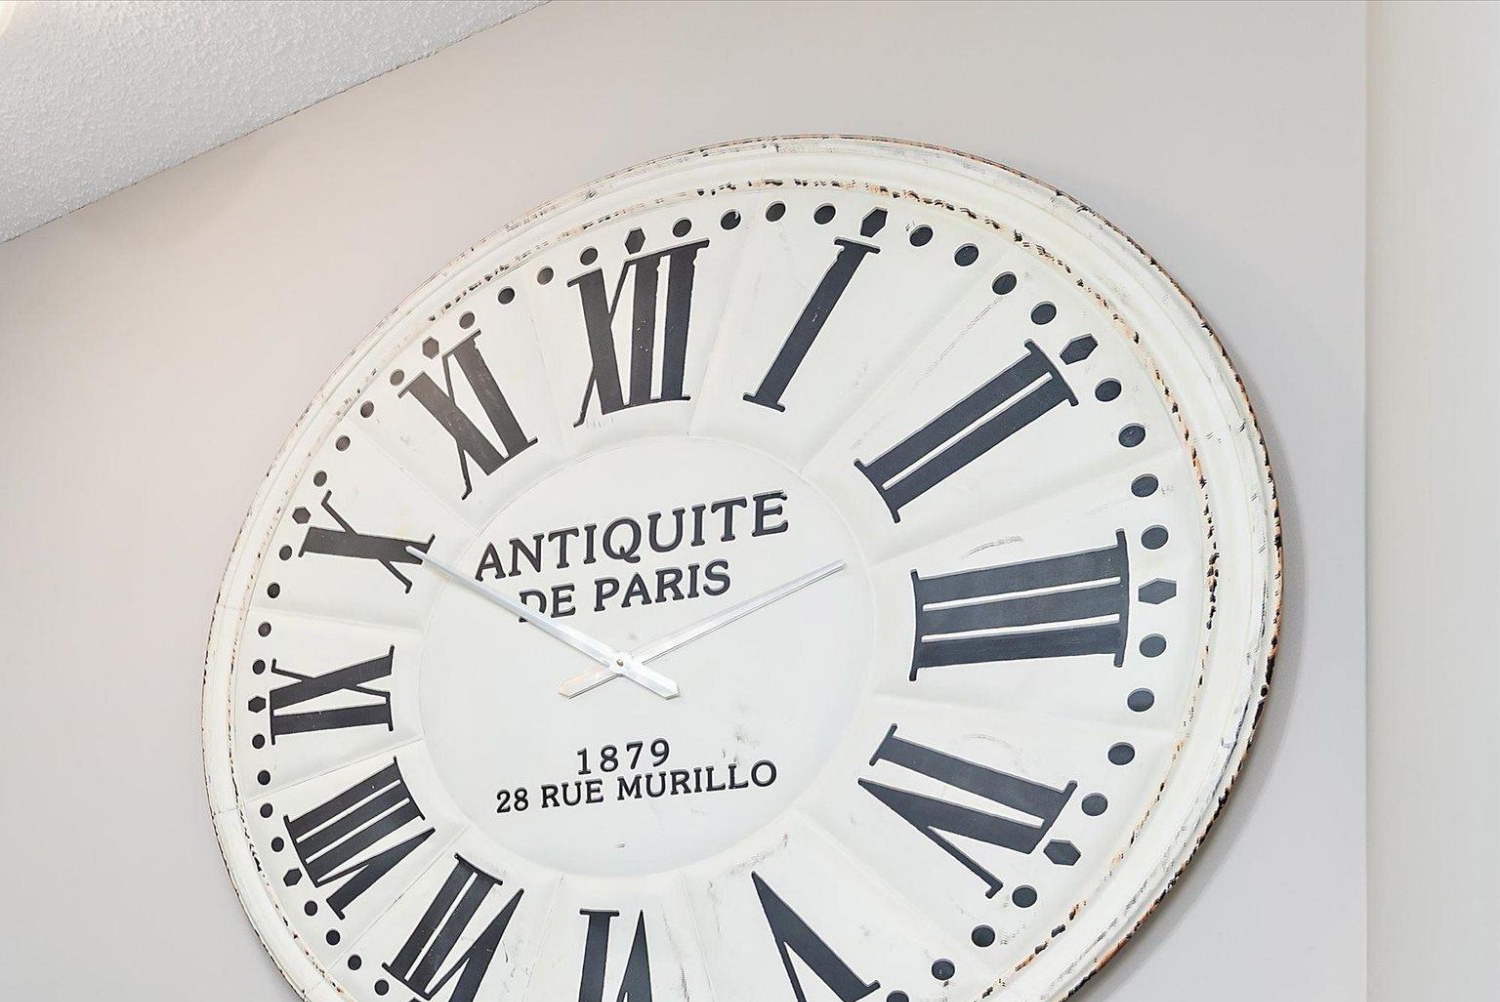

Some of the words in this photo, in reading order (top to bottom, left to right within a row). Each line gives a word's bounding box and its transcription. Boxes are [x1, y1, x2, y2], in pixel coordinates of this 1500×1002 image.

[567, 240, 710, 427] XII
[743, 239, 880, 412] I
[398, 330, 538, 500] XI
[854, 341, 1079, 523] II
[298, 491, 435, 594] X
[475, 491, 789, 582] ANTIQUITE
[519, 584, 576, 623] DE
[594, 559, 731, 612] PARIS
[909, 531, 1129, 681] III
[269, 646, 395, 745] IX
[577, 739, 670, 776] 1879
[283, 757, 435, 920] VIII
[496, 788, 529, 814] 28
[541, 780, 604, 809] RUE
[617, 760, 777, 801] MURILLO
[858, 724, 1077, 899] IV
